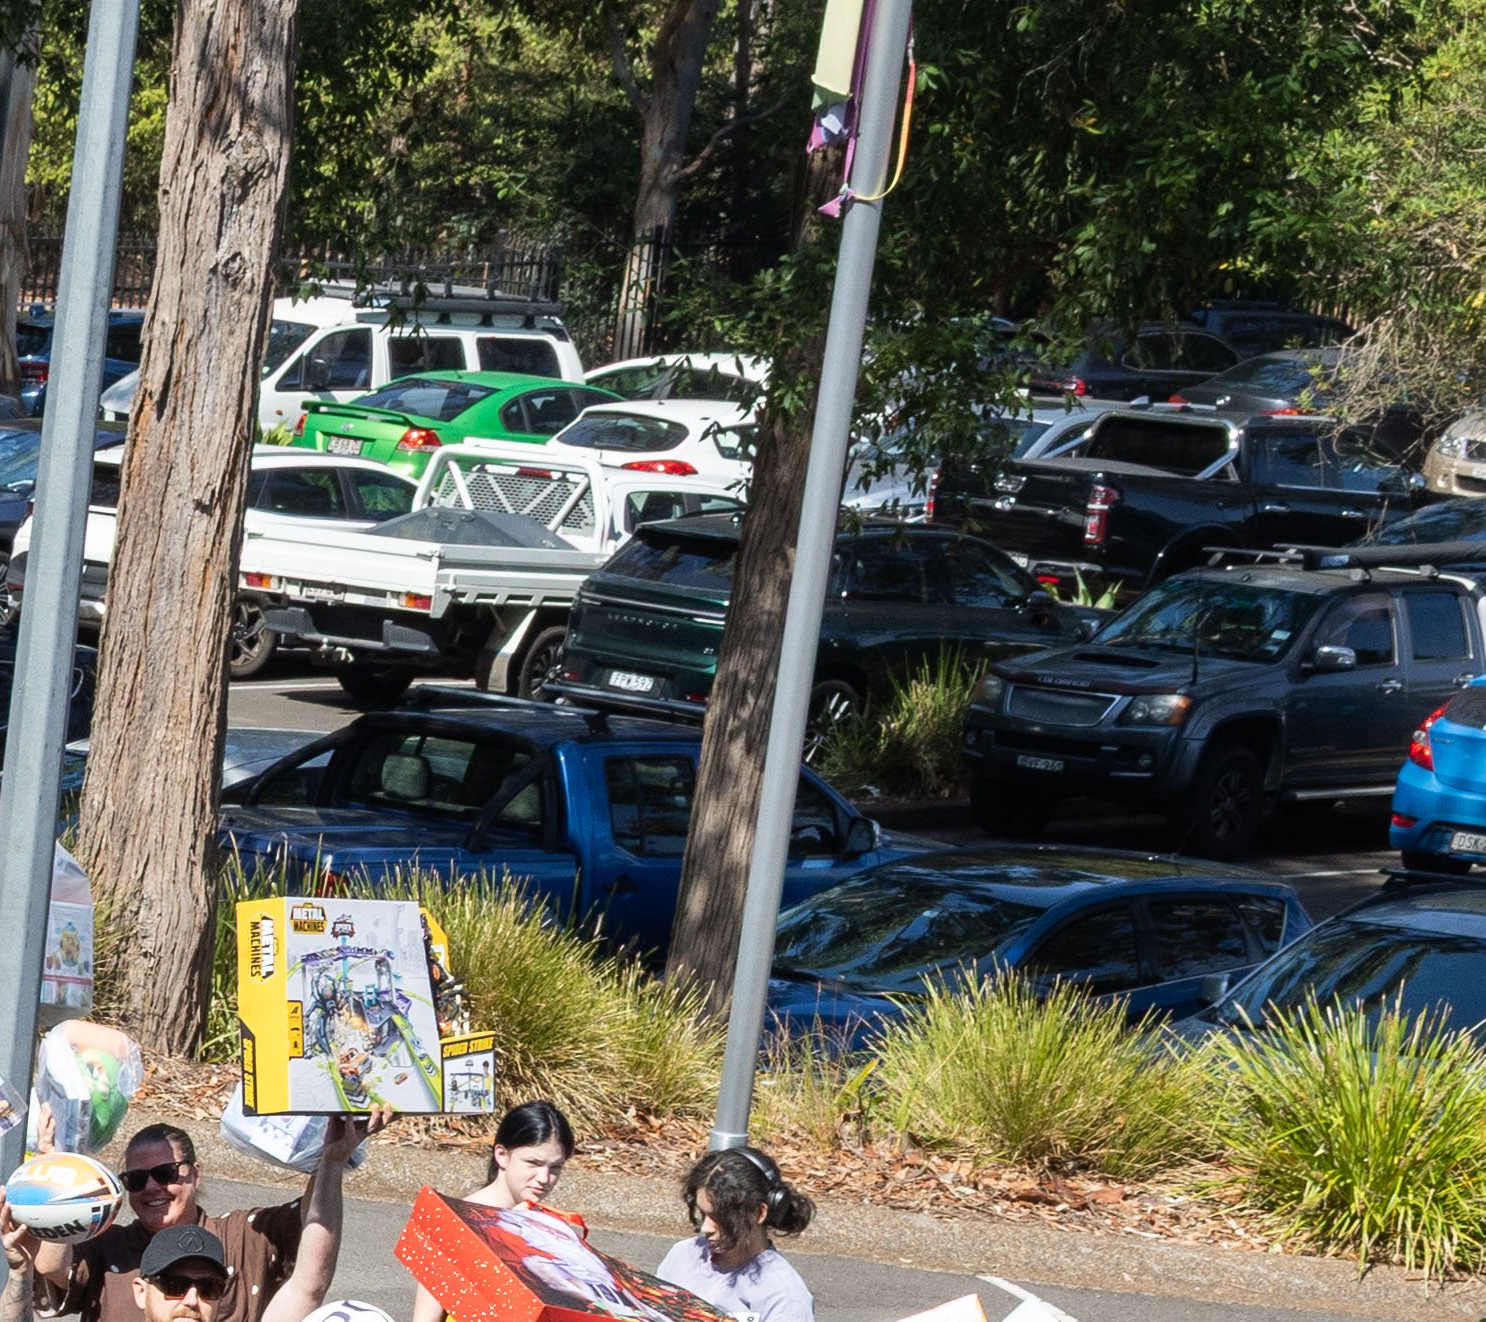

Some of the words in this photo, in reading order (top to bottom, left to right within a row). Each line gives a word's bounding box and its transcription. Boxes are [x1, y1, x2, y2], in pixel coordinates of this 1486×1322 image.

[293, 906, 325, 922] METAL
[293, 922, 325, 934] MACHINES
[250, 920, 260, 979] MACHINES
[260, 919, 274, 979] METAL
[243, 1038, 254, 1070] SPIDER
[443, 1043, 467, 1056] SPIDER
[469, 1039, 493, 1053] STRIKE
[243, 1073, 254, 1109] STRIKE
